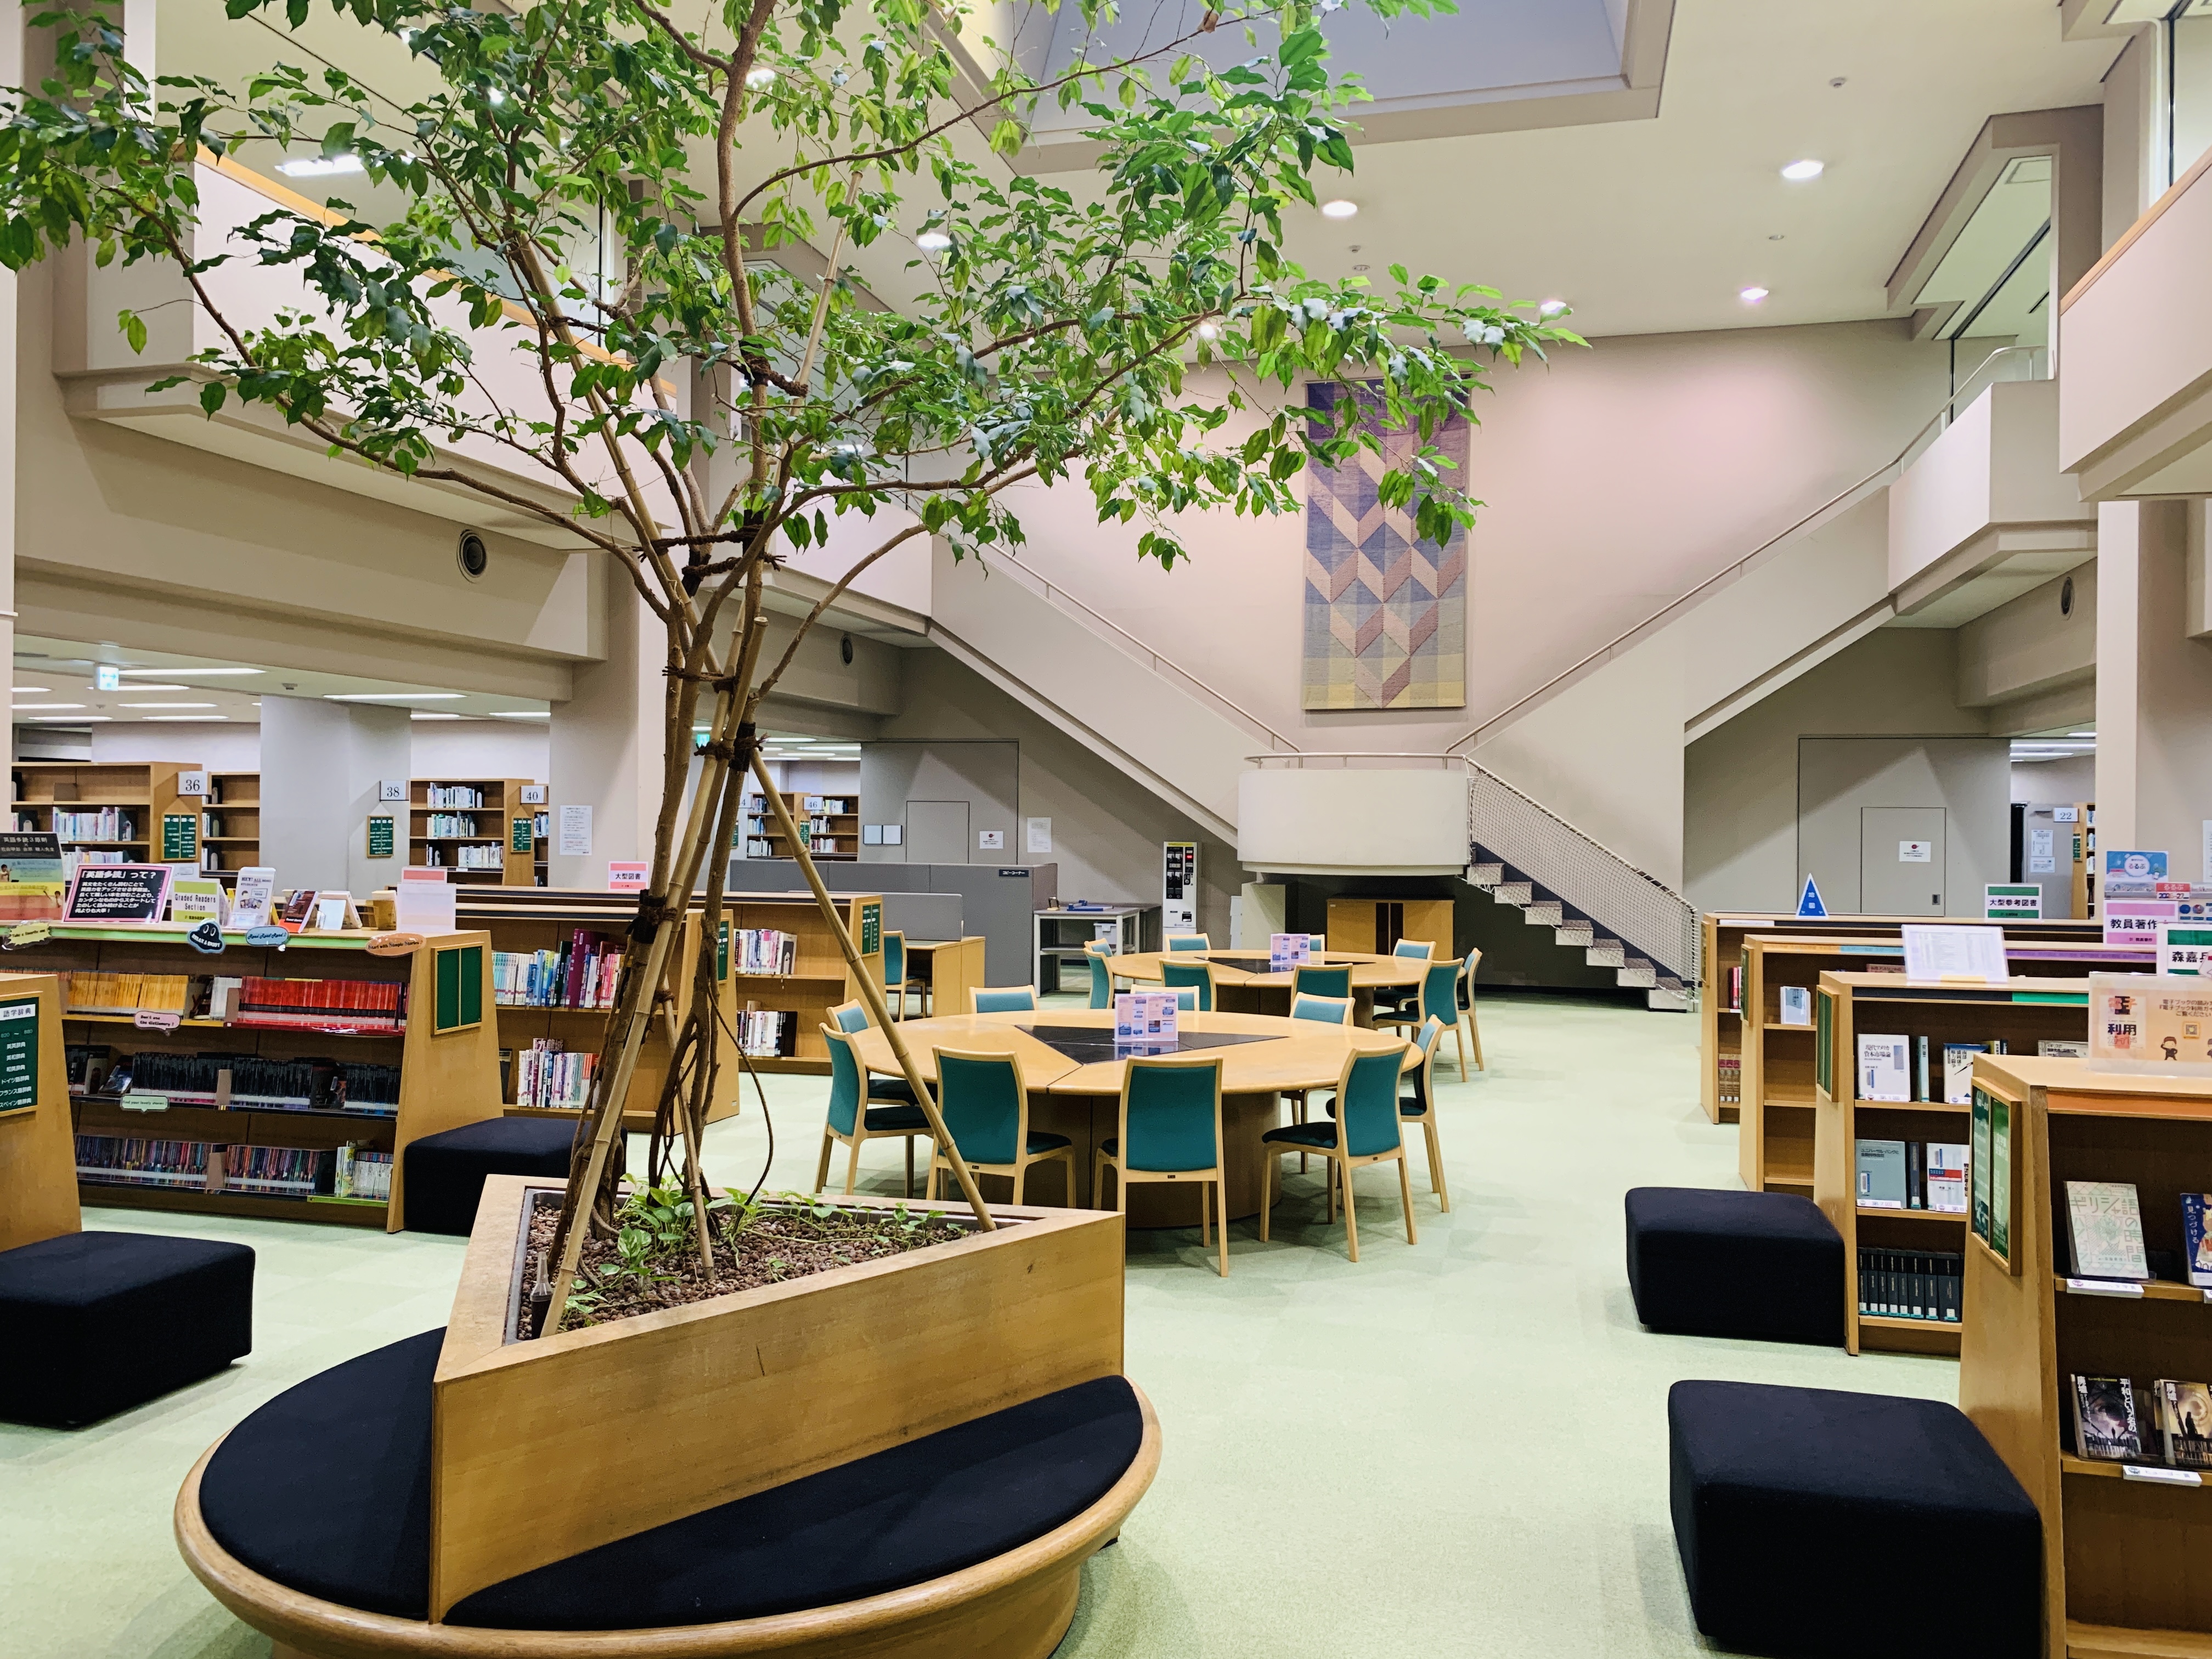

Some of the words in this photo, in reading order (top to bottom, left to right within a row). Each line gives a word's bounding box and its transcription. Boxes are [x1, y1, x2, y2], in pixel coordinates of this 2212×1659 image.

[185, 779, 200, 792] 36
[387, 787, 399, 798] 38
[526, 792, 538, 801] 40
[175, 894, 193, 902] Graded
[195, 894, 216, 903] Readers
[184, 902, 206, 911] Section
[2110, 919, 2157, 929] 教員著作
[3, 1008, 31, 1017] 語学辞典
[2108, 1024, 2136, 1036] 利用
[7, 1053, 25, 1061] 英和辞典
